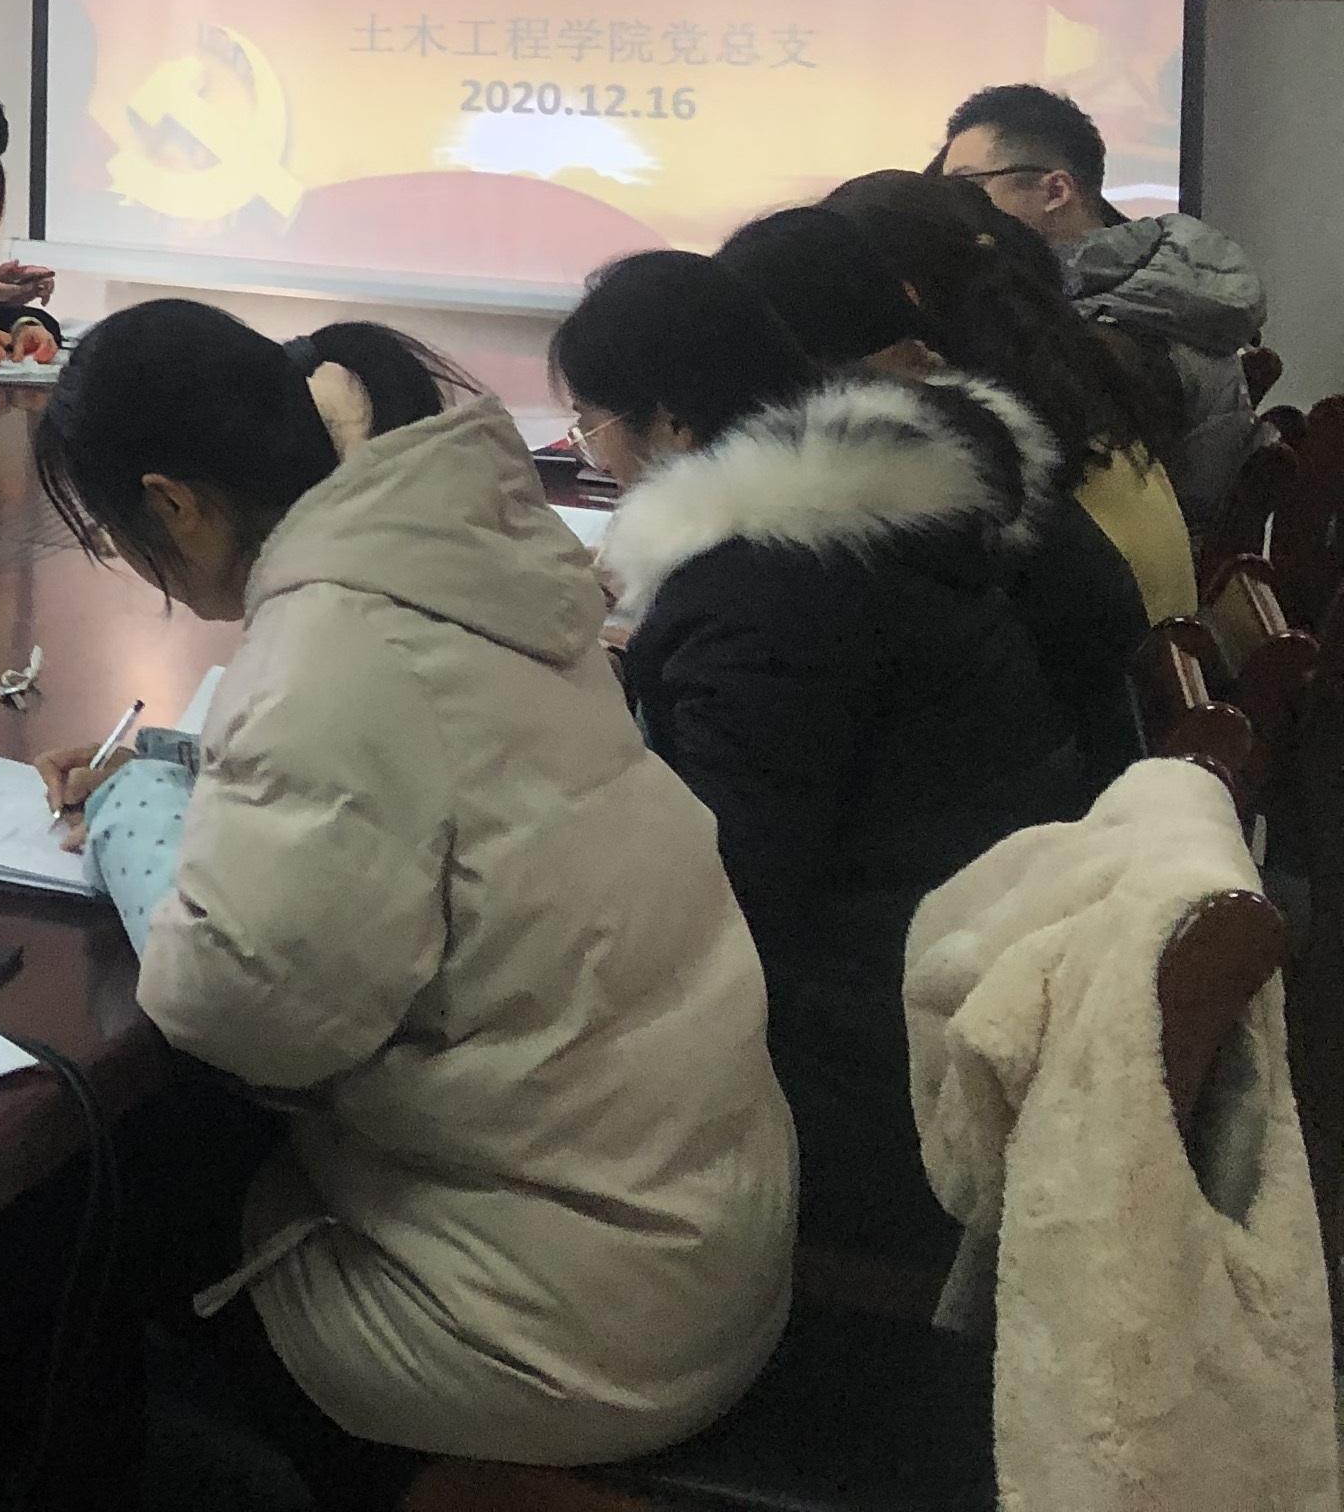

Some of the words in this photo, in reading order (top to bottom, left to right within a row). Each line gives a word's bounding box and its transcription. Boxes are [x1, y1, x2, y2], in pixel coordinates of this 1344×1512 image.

[349, 12, 818, 69] 土木工程学院党总支
[459, 79, 698, 121] 2020.12.16
